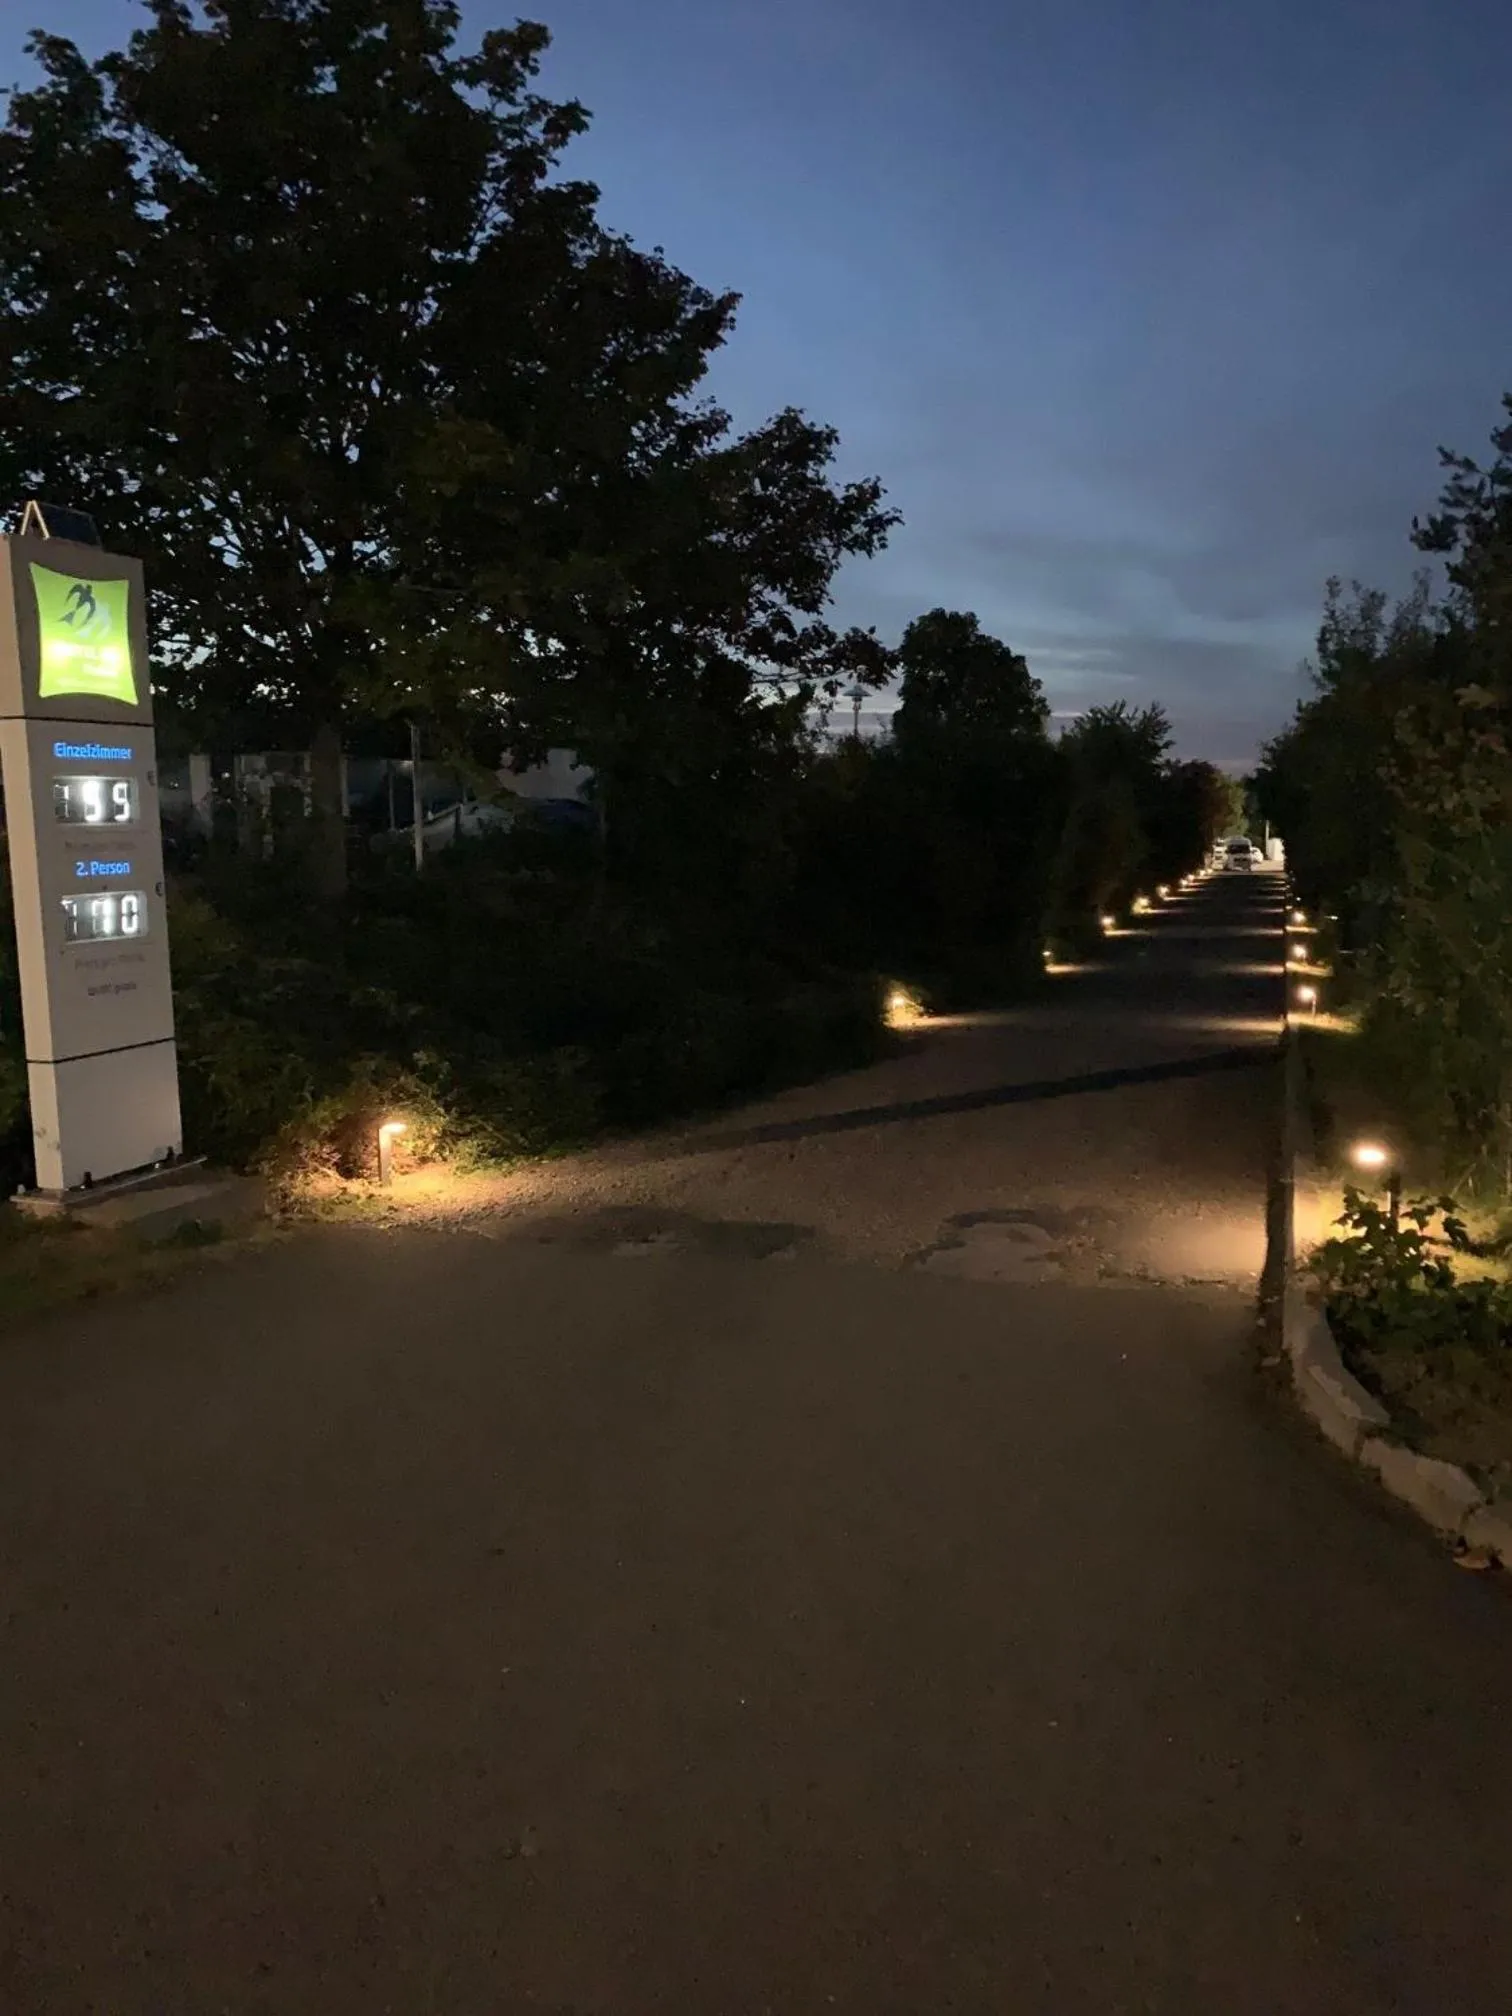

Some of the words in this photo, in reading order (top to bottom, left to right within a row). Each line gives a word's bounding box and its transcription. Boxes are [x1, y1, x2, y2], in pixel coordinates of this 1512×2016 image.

[54, 741, 132, 760] Einzelzimmer
[76, 862, 89, 876] 2.
[91, 860, 130, 876] Person
